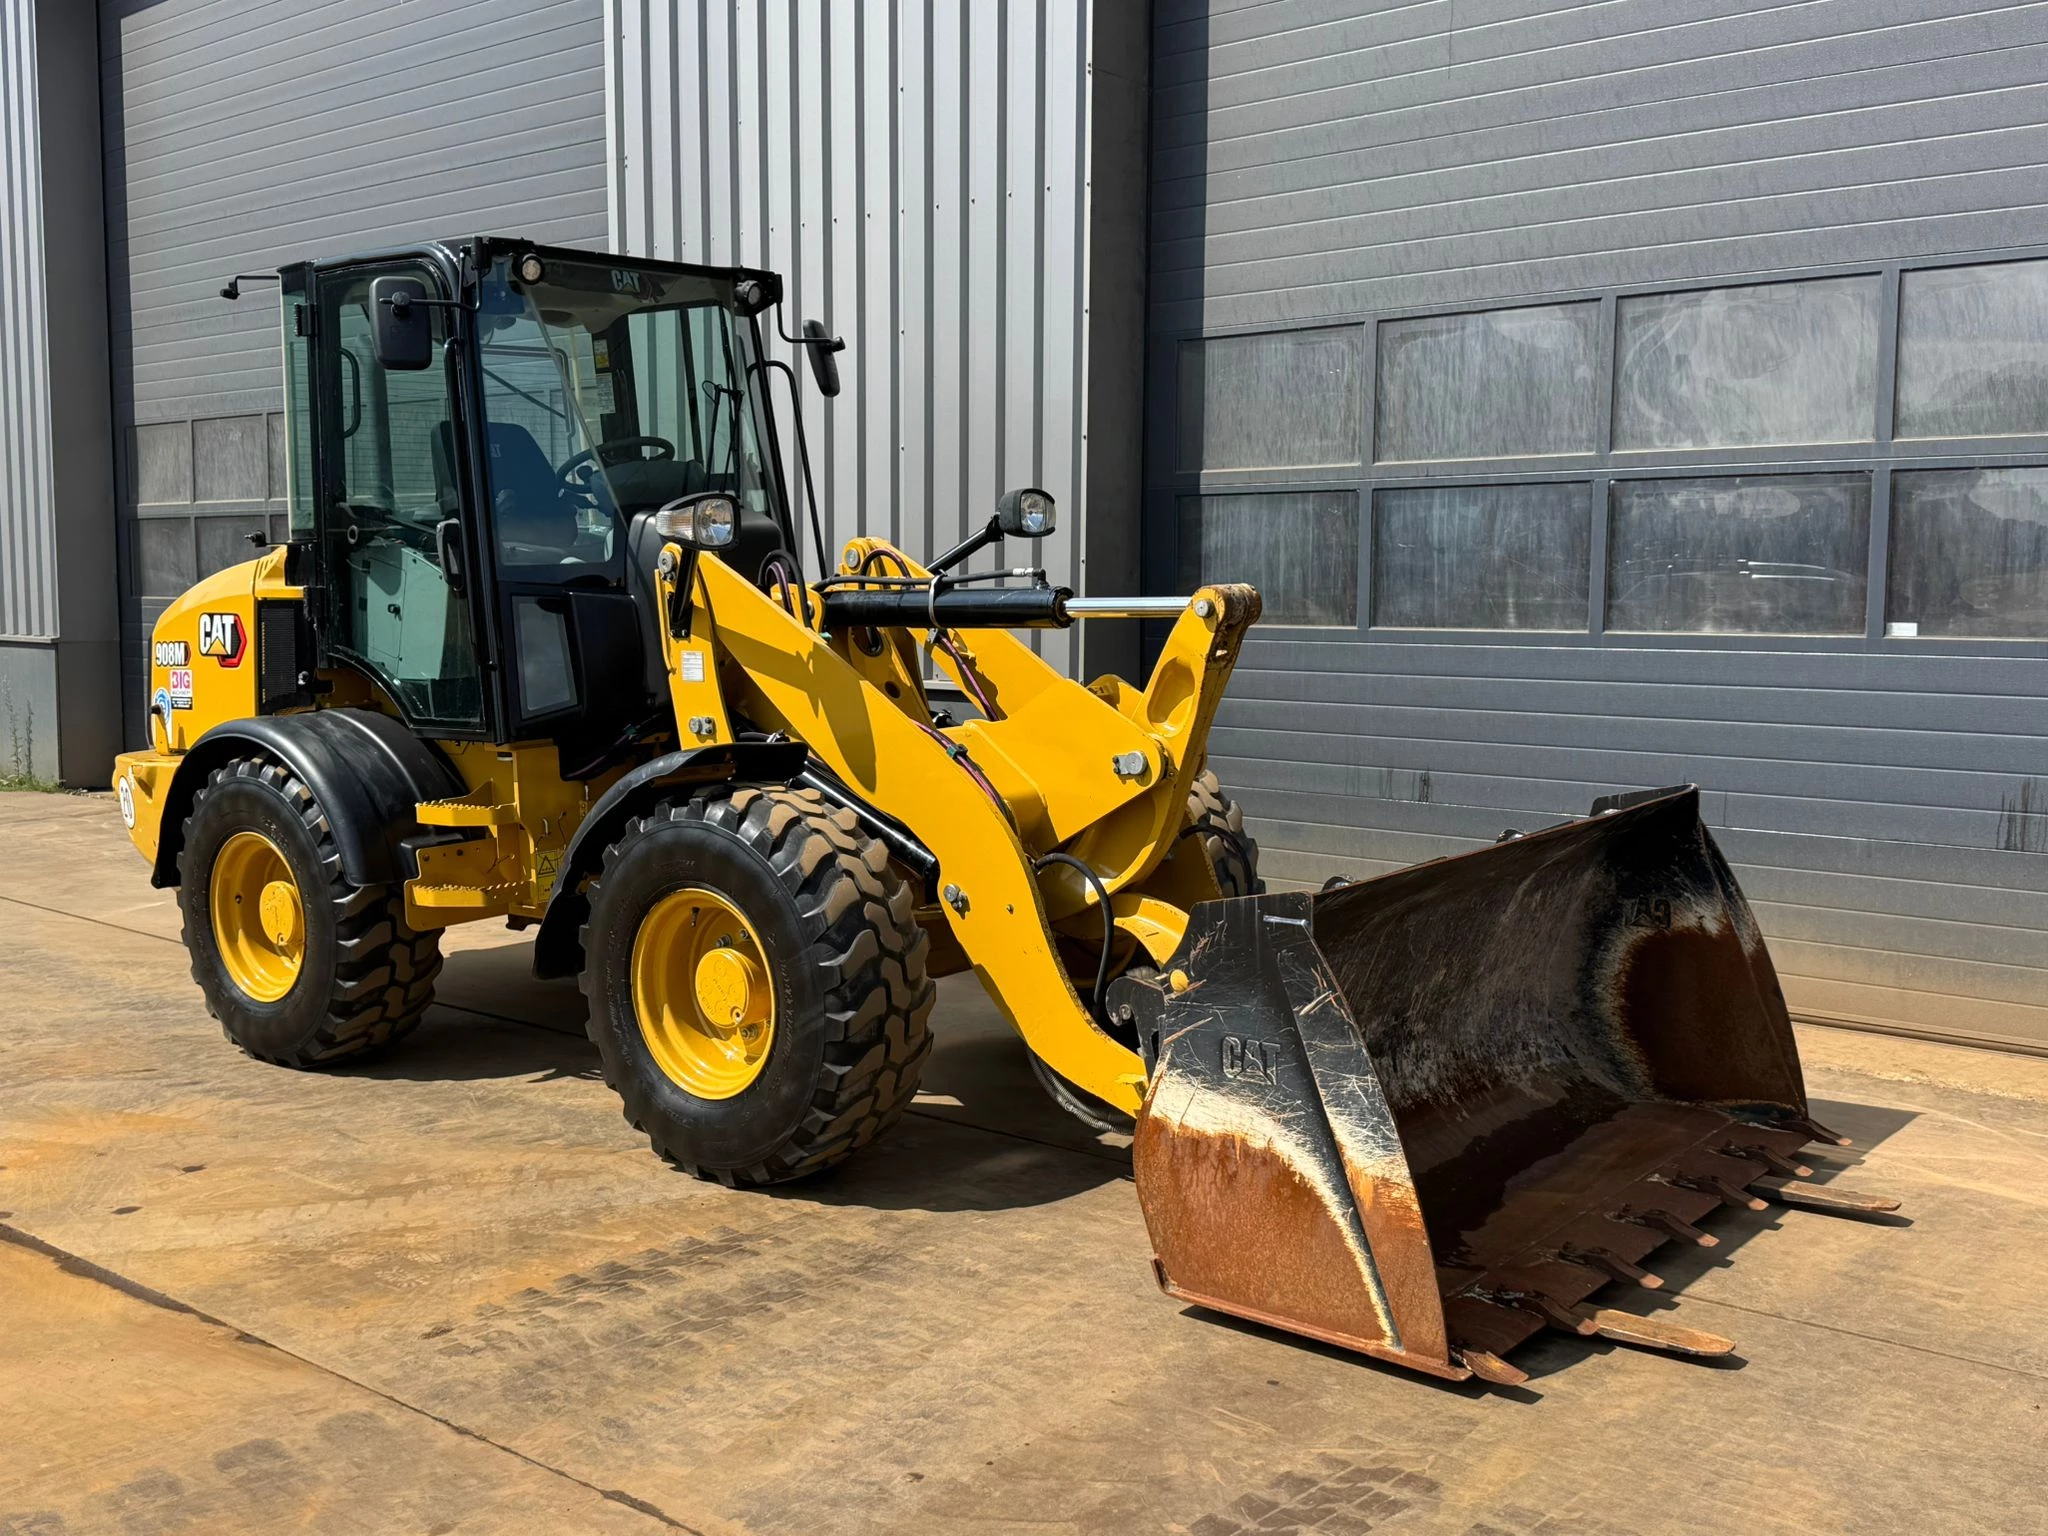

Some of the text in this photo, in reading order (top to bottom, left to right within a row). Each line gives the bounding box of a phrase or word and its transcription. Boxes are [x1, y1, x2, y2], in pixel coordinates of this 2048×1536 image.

[611, 269, 641, 293] CAT
[199, 613, 235, 656] CAT
[155, 641, 186, 667] 908M
[171, 671, 191, 689] BIG
[1222, 1036, 1281, 1086] CAT
